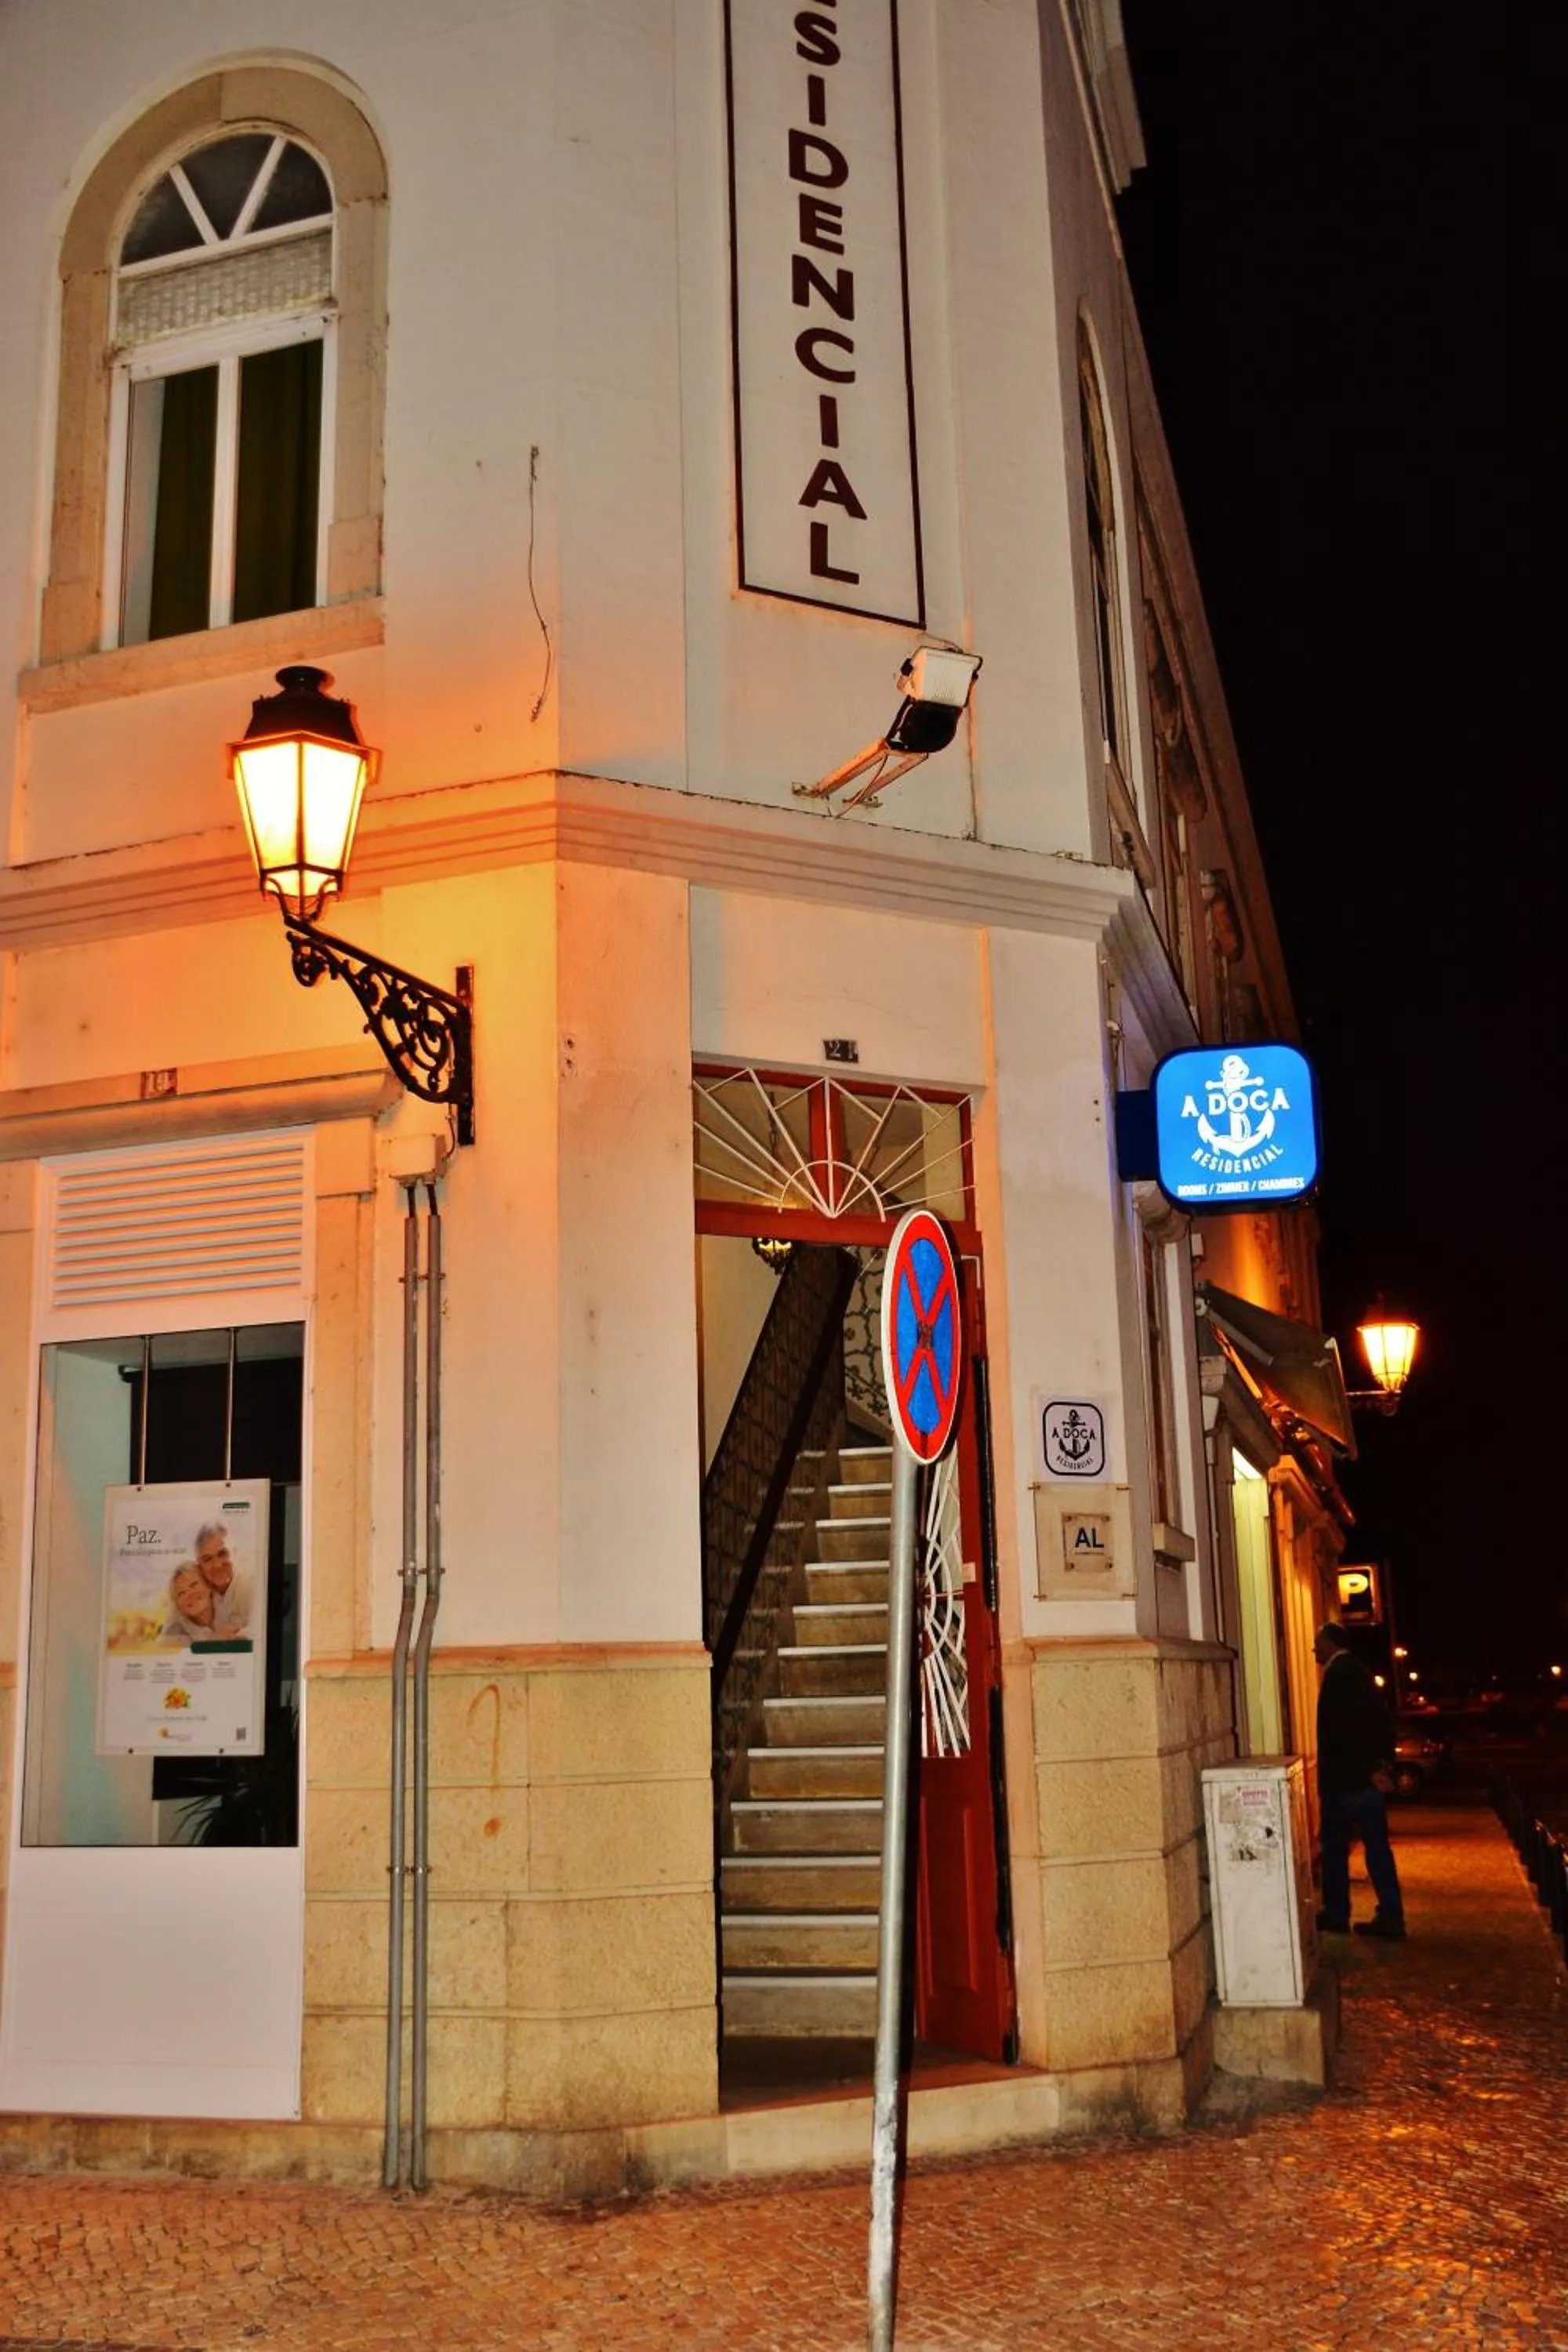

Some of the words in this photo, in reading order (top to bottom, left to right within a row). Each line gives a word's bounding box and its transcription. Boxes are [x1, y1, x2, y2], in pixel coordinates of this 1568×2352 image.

[787, 0, 867, 585] SIDENCIAL
[1181, 1095, 1200, 1117] A
[1208, 1087, 1290, 1115] DOCA
[1191, 1144, 1284, 1174] RESIDENCIAL
[1051, 1426, 1059, 1439] A
[1063, 1427, 1096, 1440] DOCA
[125, 1525, 162, 1544] Paz.
[1075, 1527, 1104, 1548] AL
[1338, 1573, 1369, 1604] P
